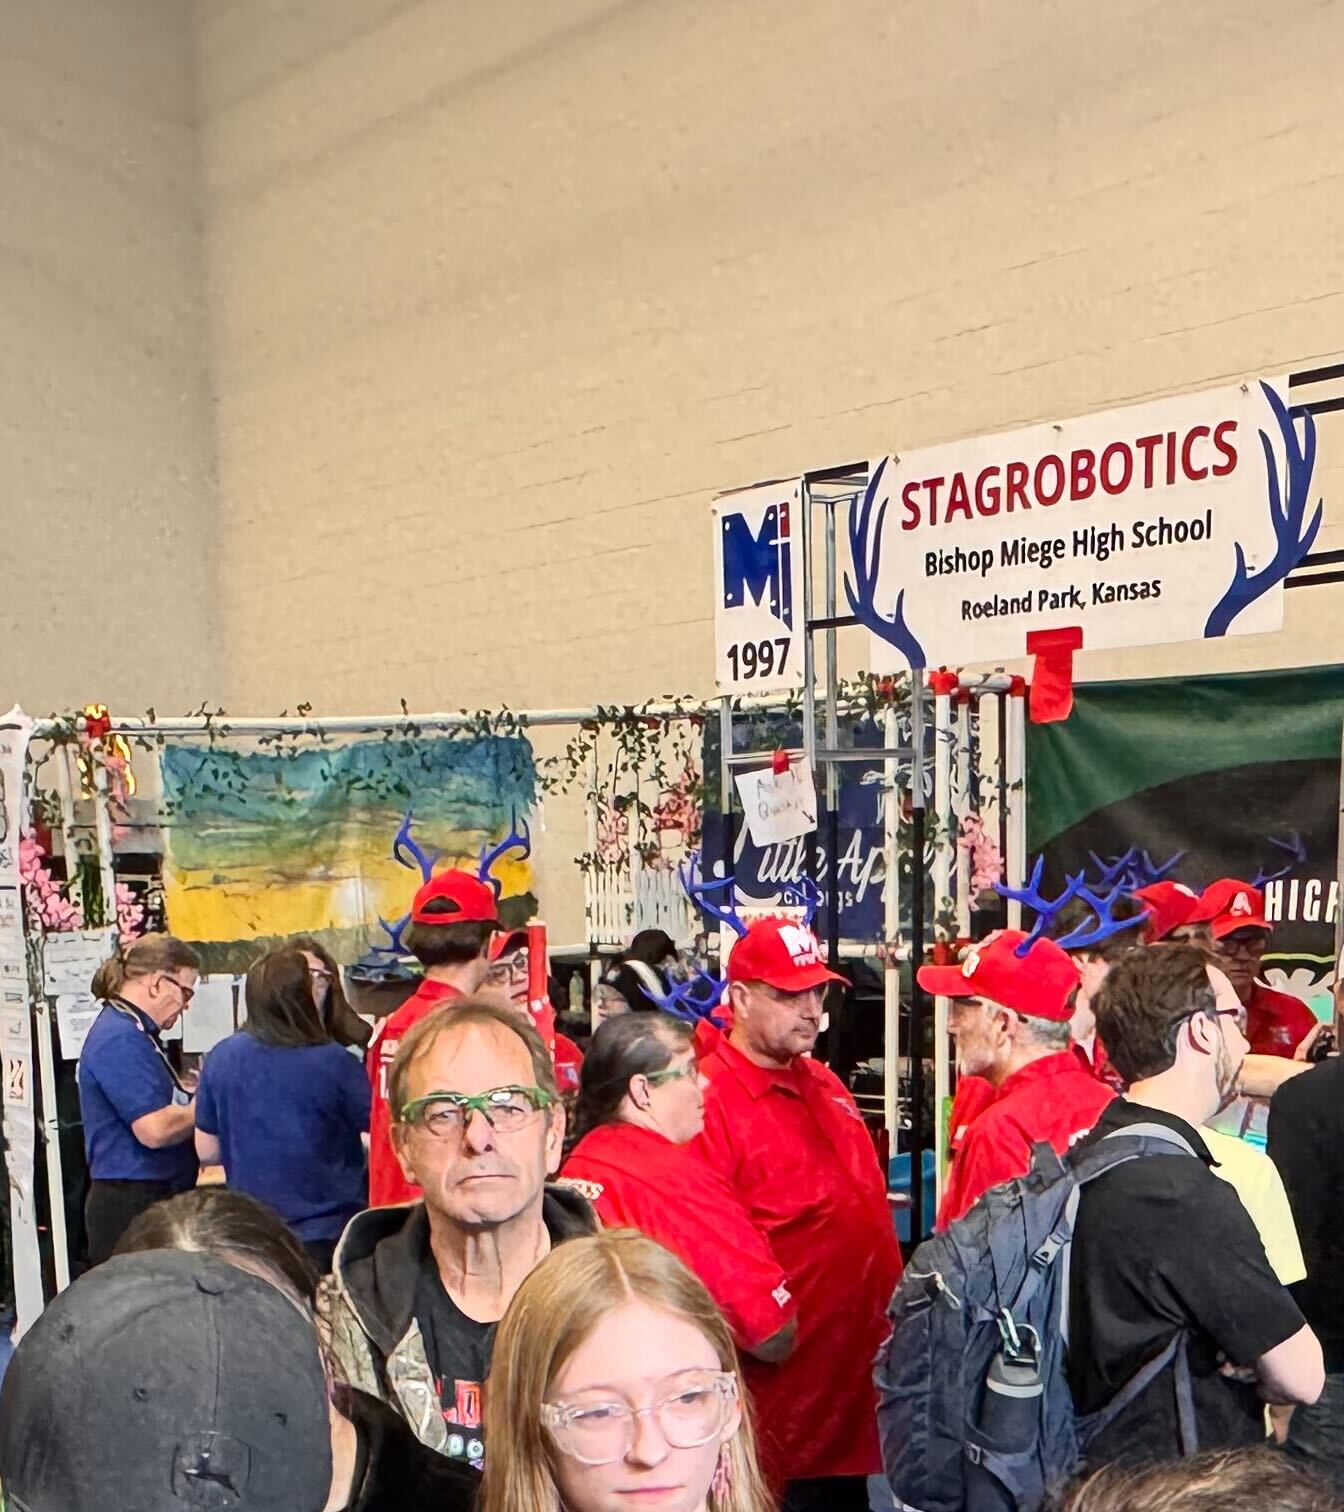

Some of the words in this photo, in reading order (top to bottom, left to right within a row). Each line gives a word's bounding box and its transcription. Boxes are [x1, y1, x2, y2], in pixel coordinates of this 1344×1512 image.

[901, 420, 1239, 531] STAGROBOTICS
[924, 546, 995, 577] Bishop
[1000, 537, 1066, 569] Miege
[1072, 522, 1125, 561] High
[1131, 509, 1212, 549] School
[961, 590, 1033, 621] Roeland
[1038, 584, 1086, 611] Park,
[1092, 578, 1162, 606] Kansas
[727, 637, 791, 682] 1997
